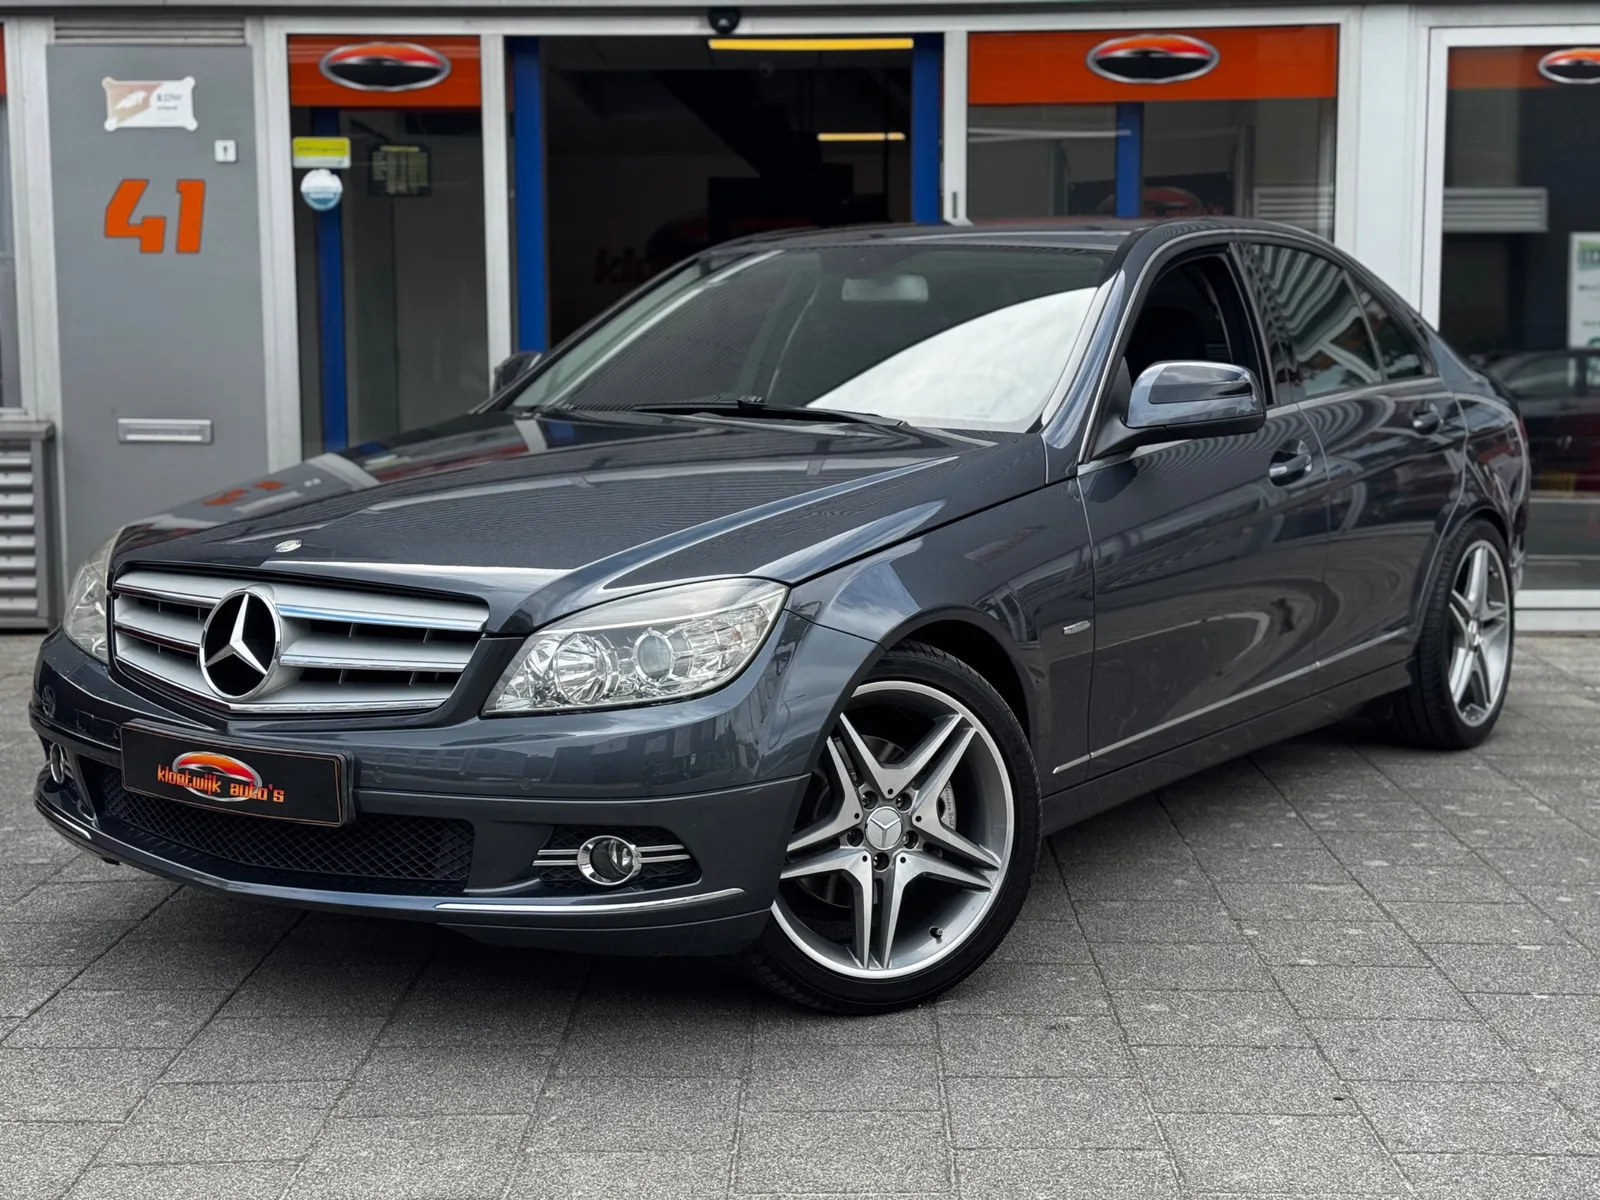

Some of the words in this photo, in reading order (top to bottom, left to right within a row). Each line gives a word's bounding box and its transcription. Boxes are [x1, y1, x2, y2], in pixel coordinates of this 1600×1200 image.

[104, 178, 205, 254] 41
[157, 764, 221, 796] klootwijk
[230, 780, 285, 803] auto's
